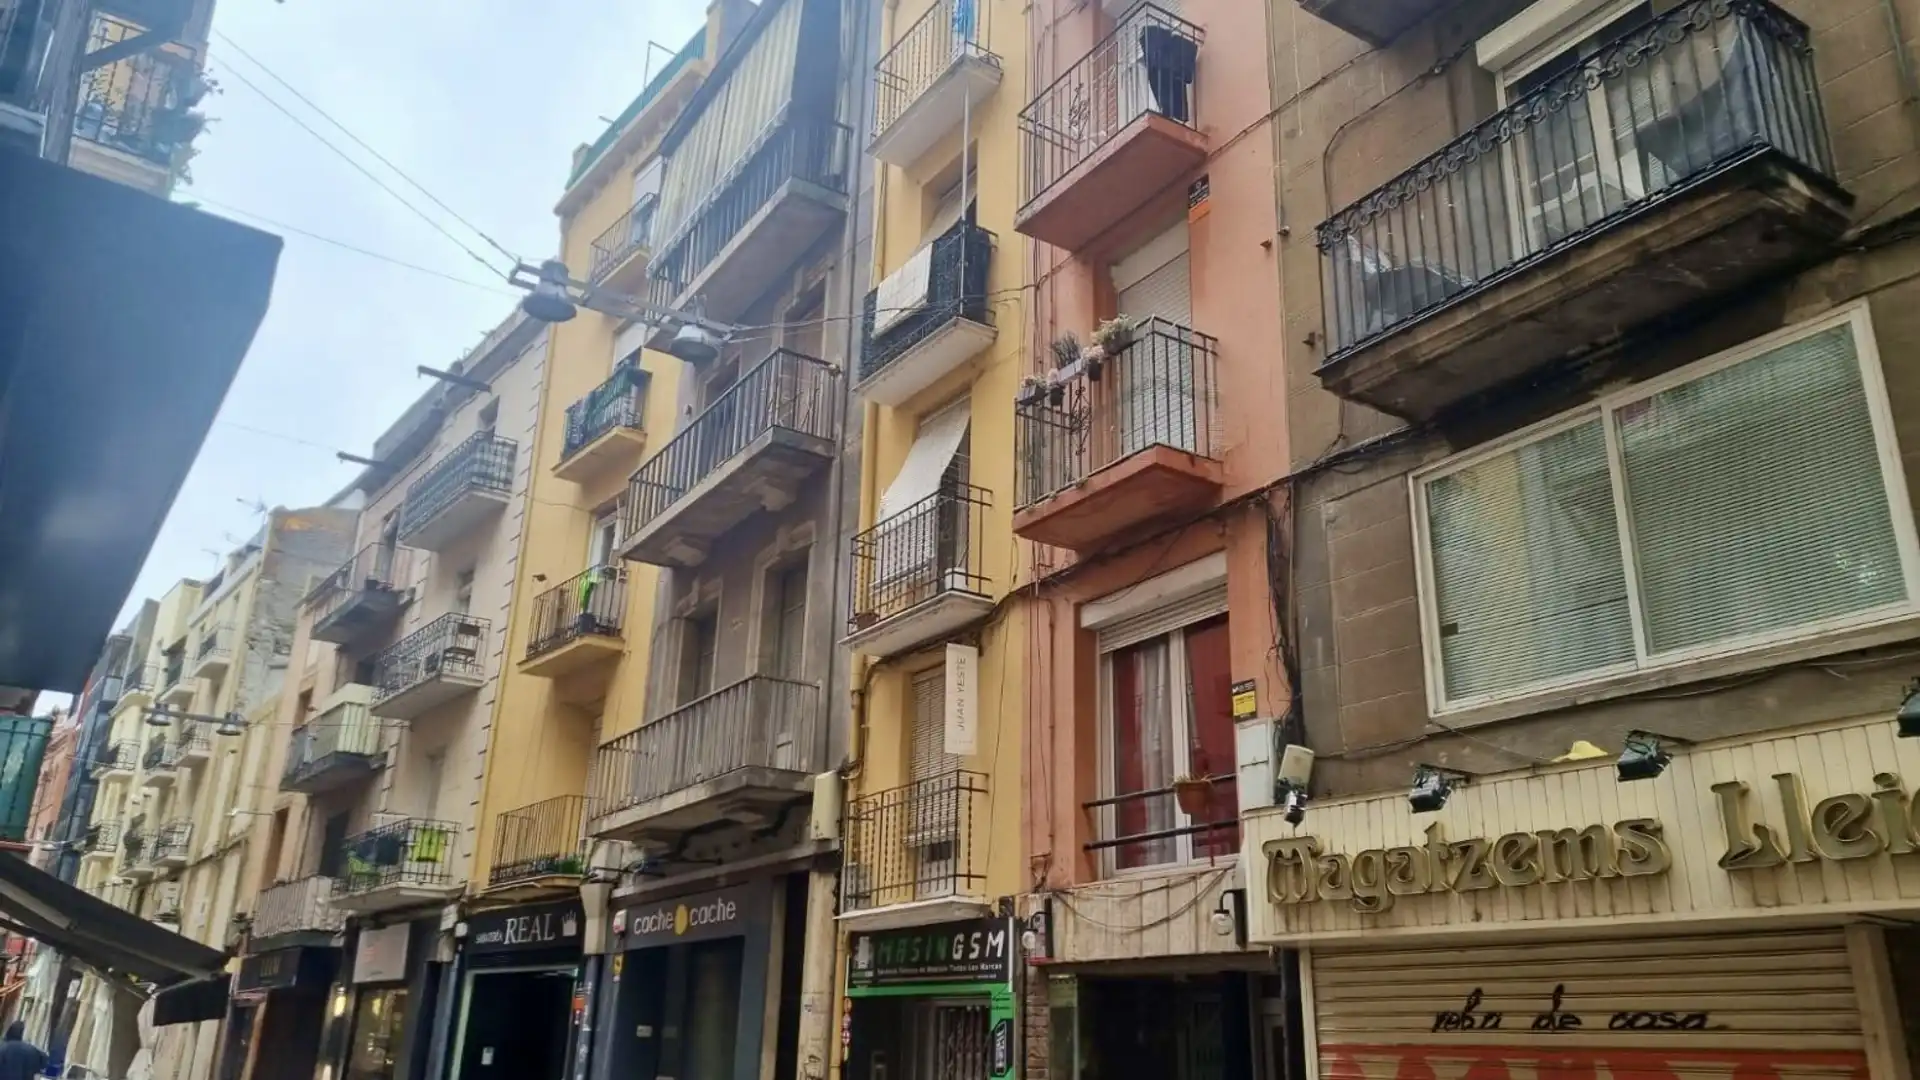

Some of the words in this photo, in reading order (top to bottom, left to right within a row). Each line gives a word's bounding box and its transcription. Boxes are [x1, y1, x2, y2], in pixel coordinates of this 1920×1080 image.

[956, 655, 967, 693] YESTE
[1261, 818, 1671, 913] Magatzems
[1711, 771, 1920, 871] Llei
[503, 913, 556, 944] REAL
[633, 907, 674, 936] cache
[689, 897, 736, 927] cache
[1531, 983, 1583, 1032] de
